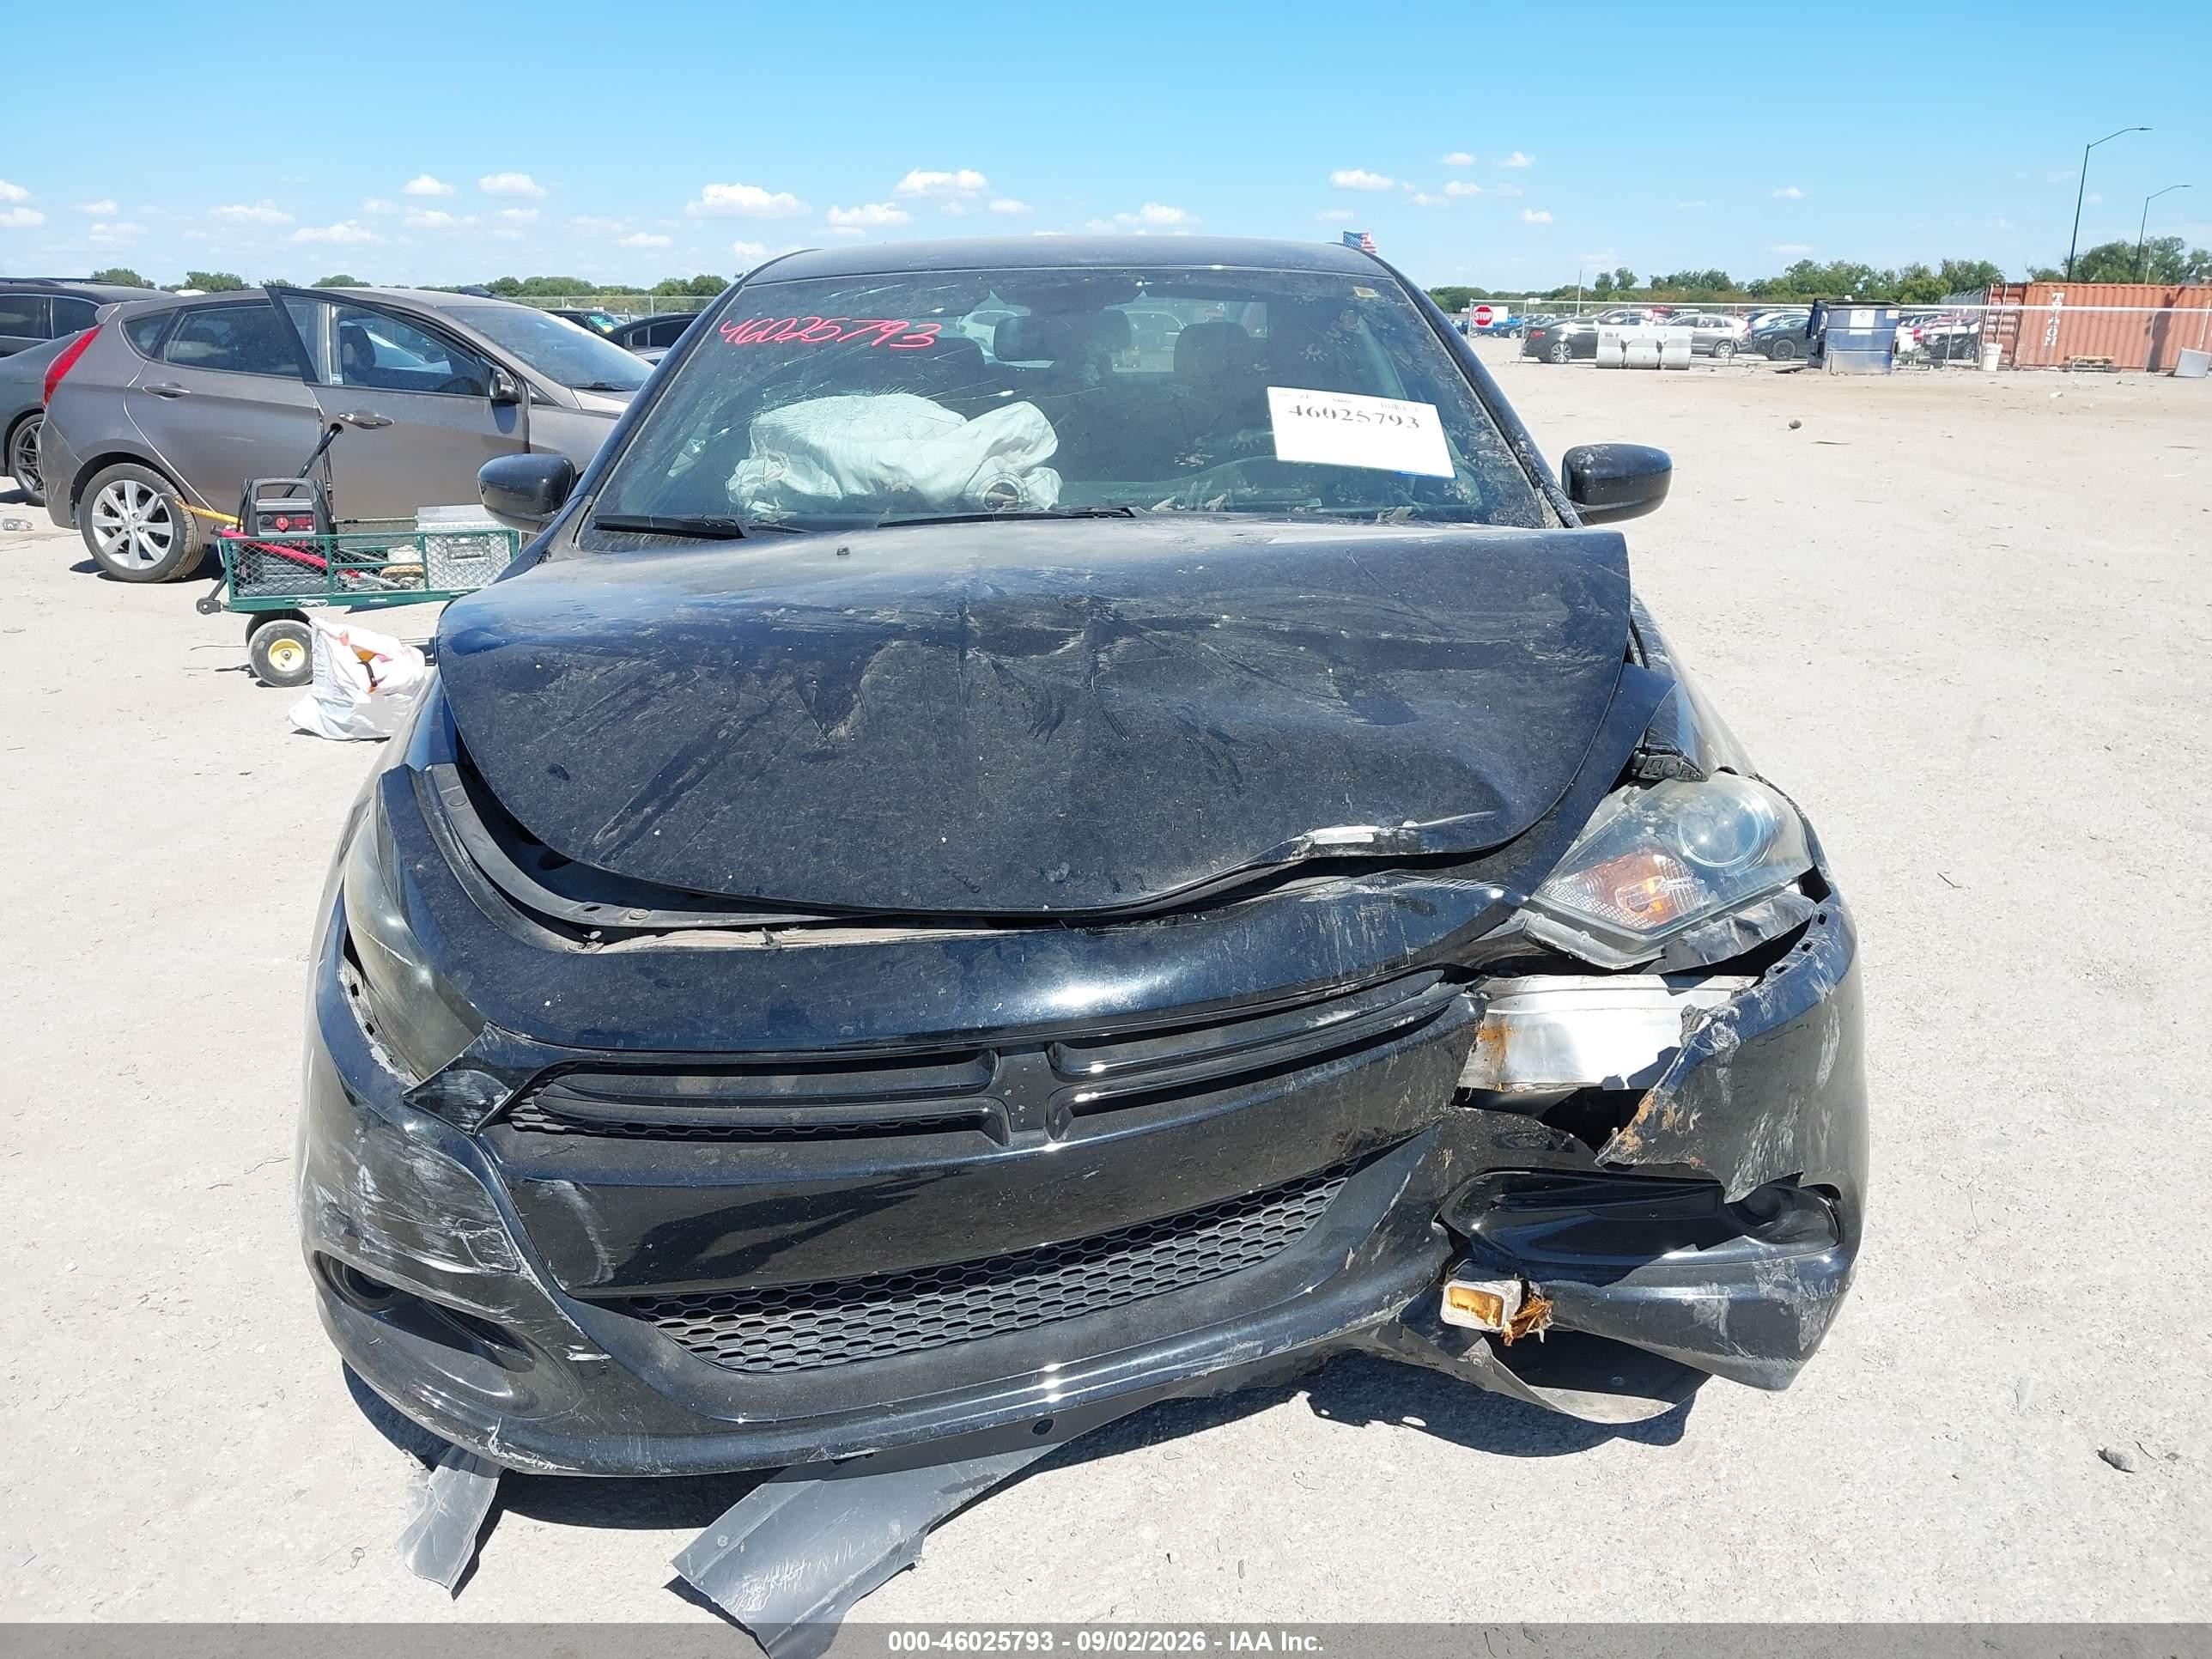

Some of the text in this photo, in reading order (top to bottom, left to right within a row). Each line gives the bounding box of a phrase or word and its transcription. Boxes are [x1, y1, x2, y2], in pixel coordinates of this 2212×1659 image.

[1474, 312, 1492, 321] STOP
[720, 316, 942, 349] 46025793
[1289, 404, 1419, 428] 46025793
